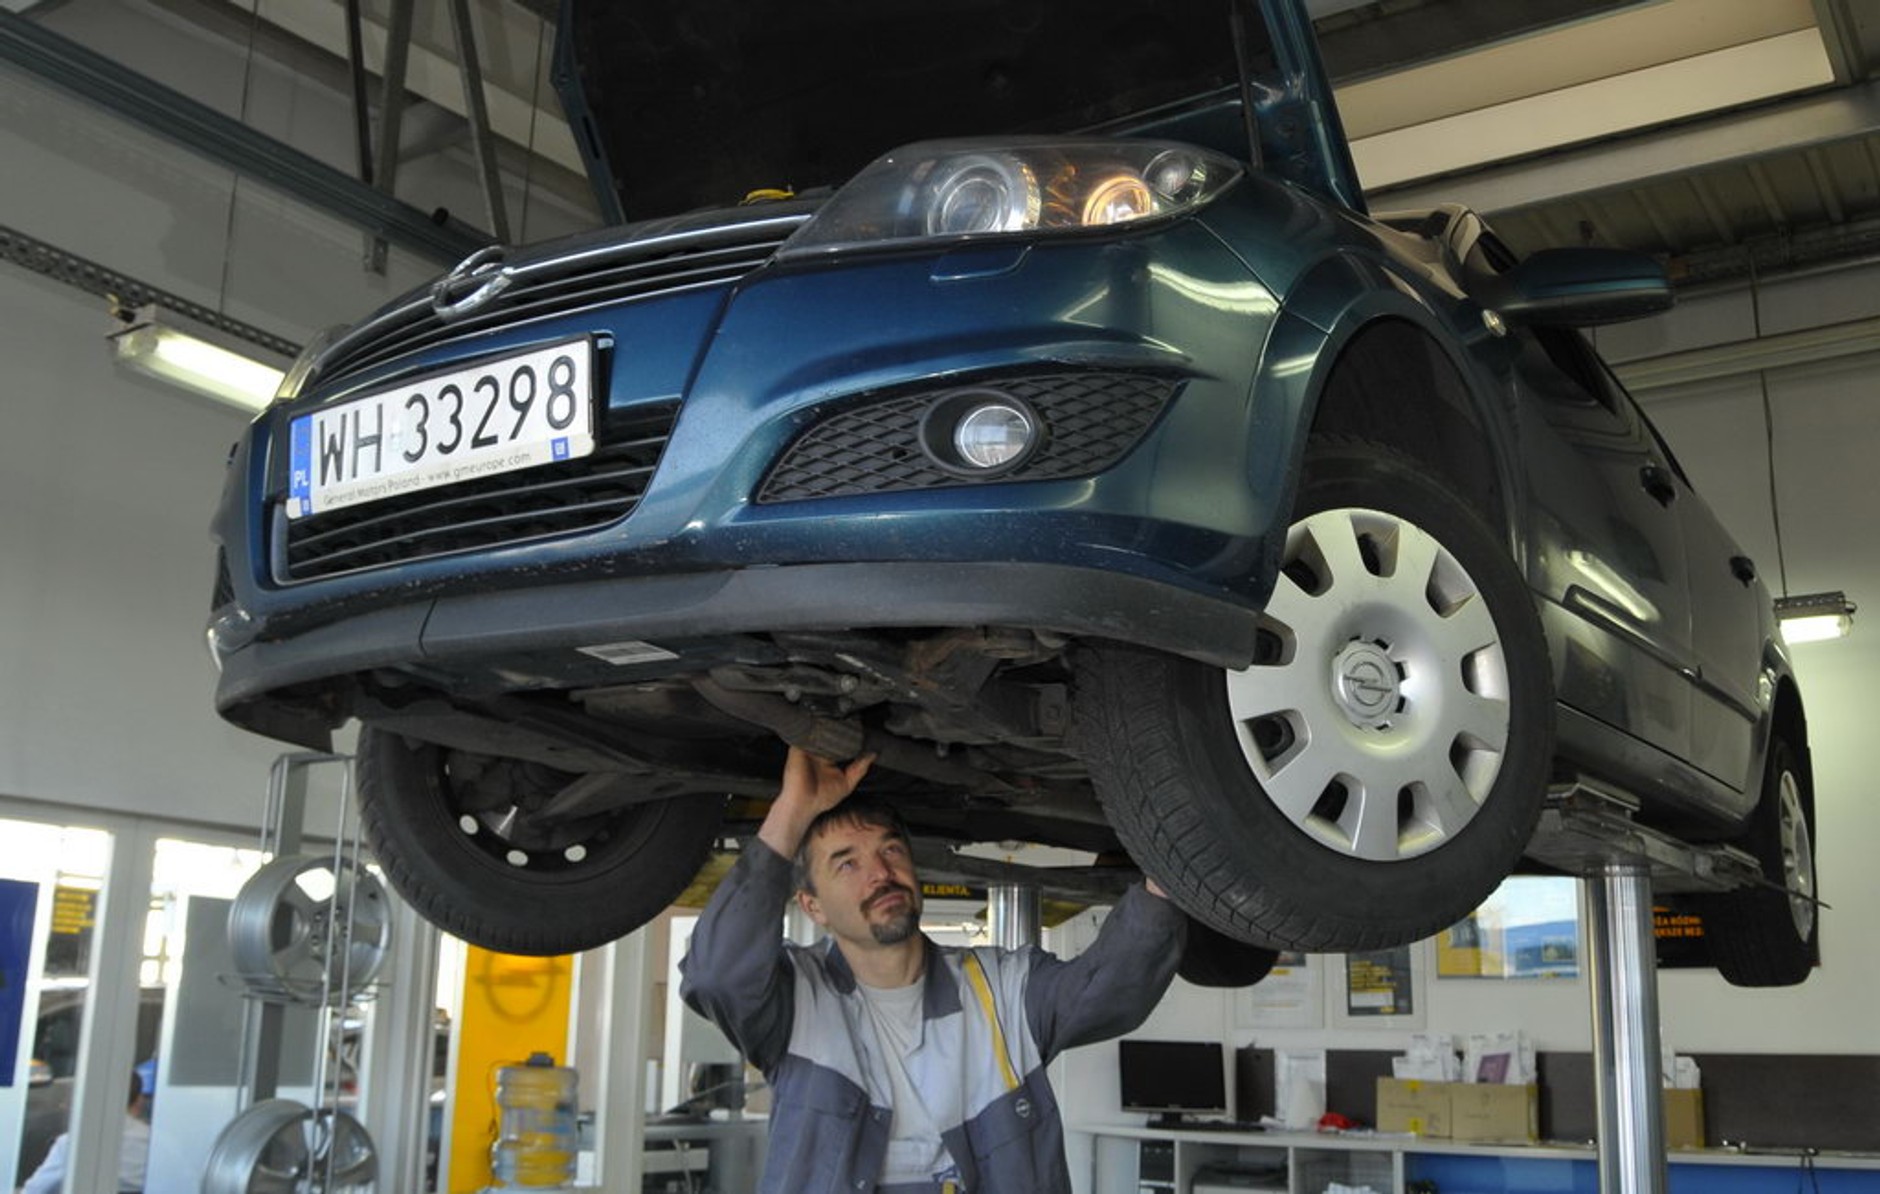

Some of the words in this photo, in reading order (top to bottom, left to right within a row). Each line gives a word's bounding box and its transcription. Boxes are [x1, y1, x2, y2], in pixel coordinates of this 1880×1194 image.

[318, 403, 383, 486] WH
[403, 354, 577, 464] 33298
[293, 470, 309, 489] PL
[323, 490, 356, 505] General
[357, 483, 388, 498] Motors
[388, 474, 420, 490] Poland
